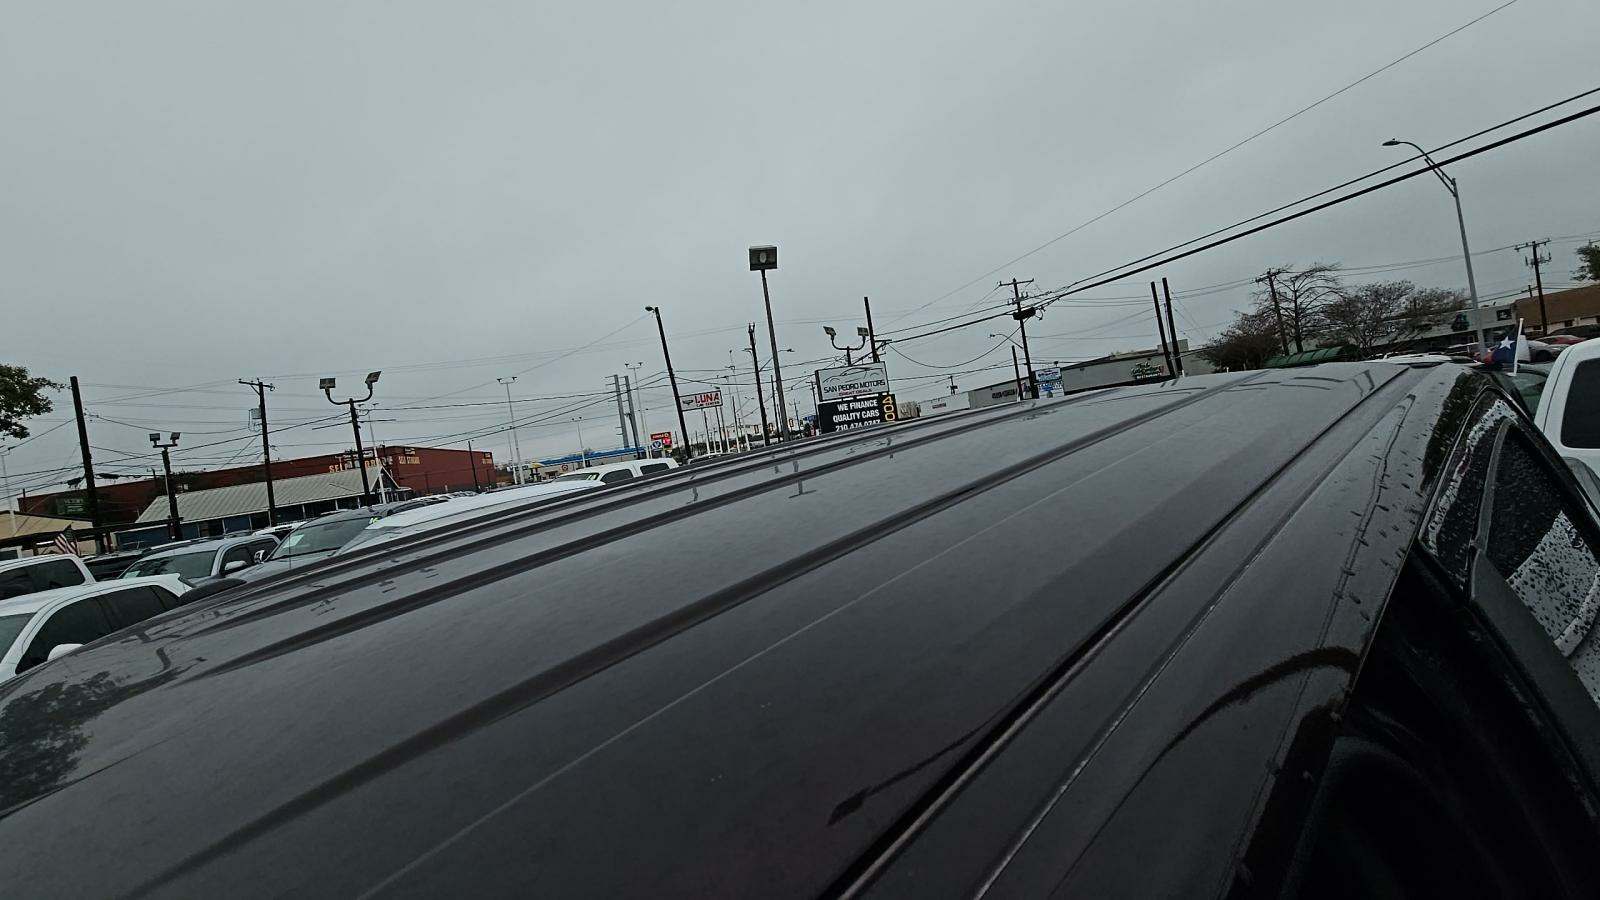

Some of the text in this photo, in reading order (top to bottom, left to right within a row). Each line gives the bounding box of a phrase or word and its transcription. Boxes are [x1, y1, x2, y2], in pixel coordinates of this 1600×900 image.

[824, 380, 885, 394] SAN PEDRO MOTORS
[695, 392, 720, 404] LUNA
[837, 400, 878, 412] WE FINANCE
[833, 409, 880, 422] QUALITY CARS
